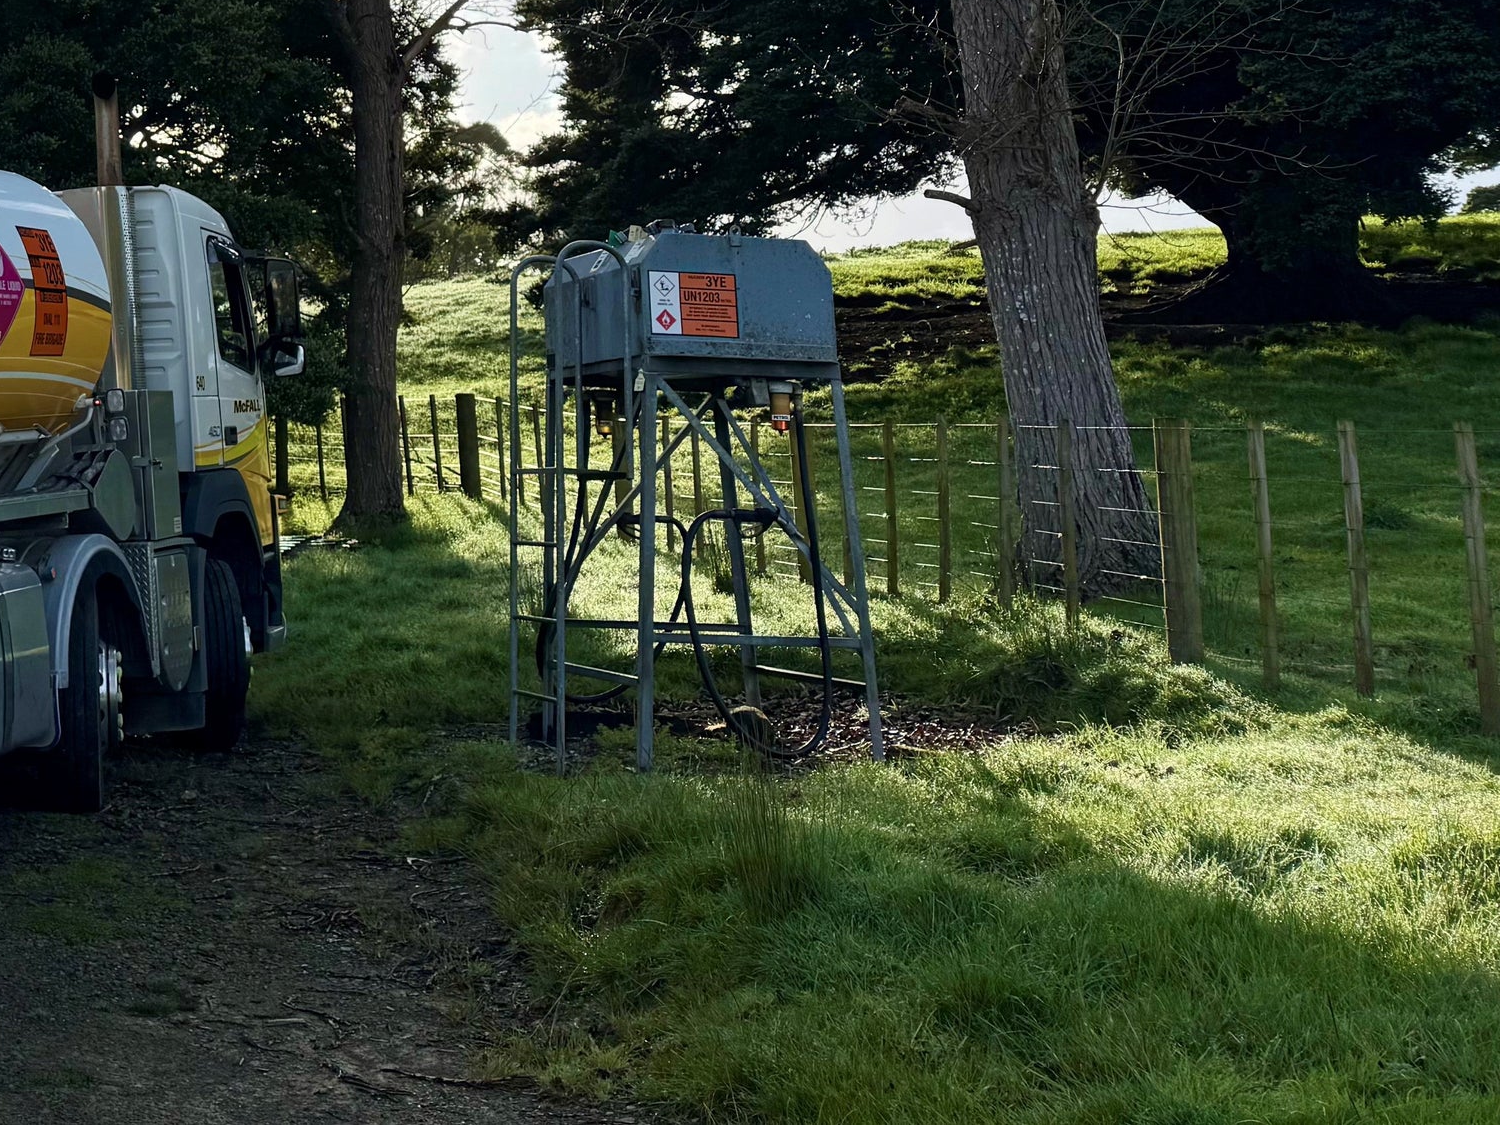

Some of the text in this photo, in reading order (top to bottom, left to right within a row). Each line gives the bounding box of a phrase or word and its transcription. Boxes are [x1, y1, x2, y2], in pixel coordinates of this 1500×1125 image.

[44, 262, 64, 286] 1203
[705, 276, 727, 288] 3YE
[683, 290, 720, 303] UN1203
[234, 399, 261, 414] McFALL
